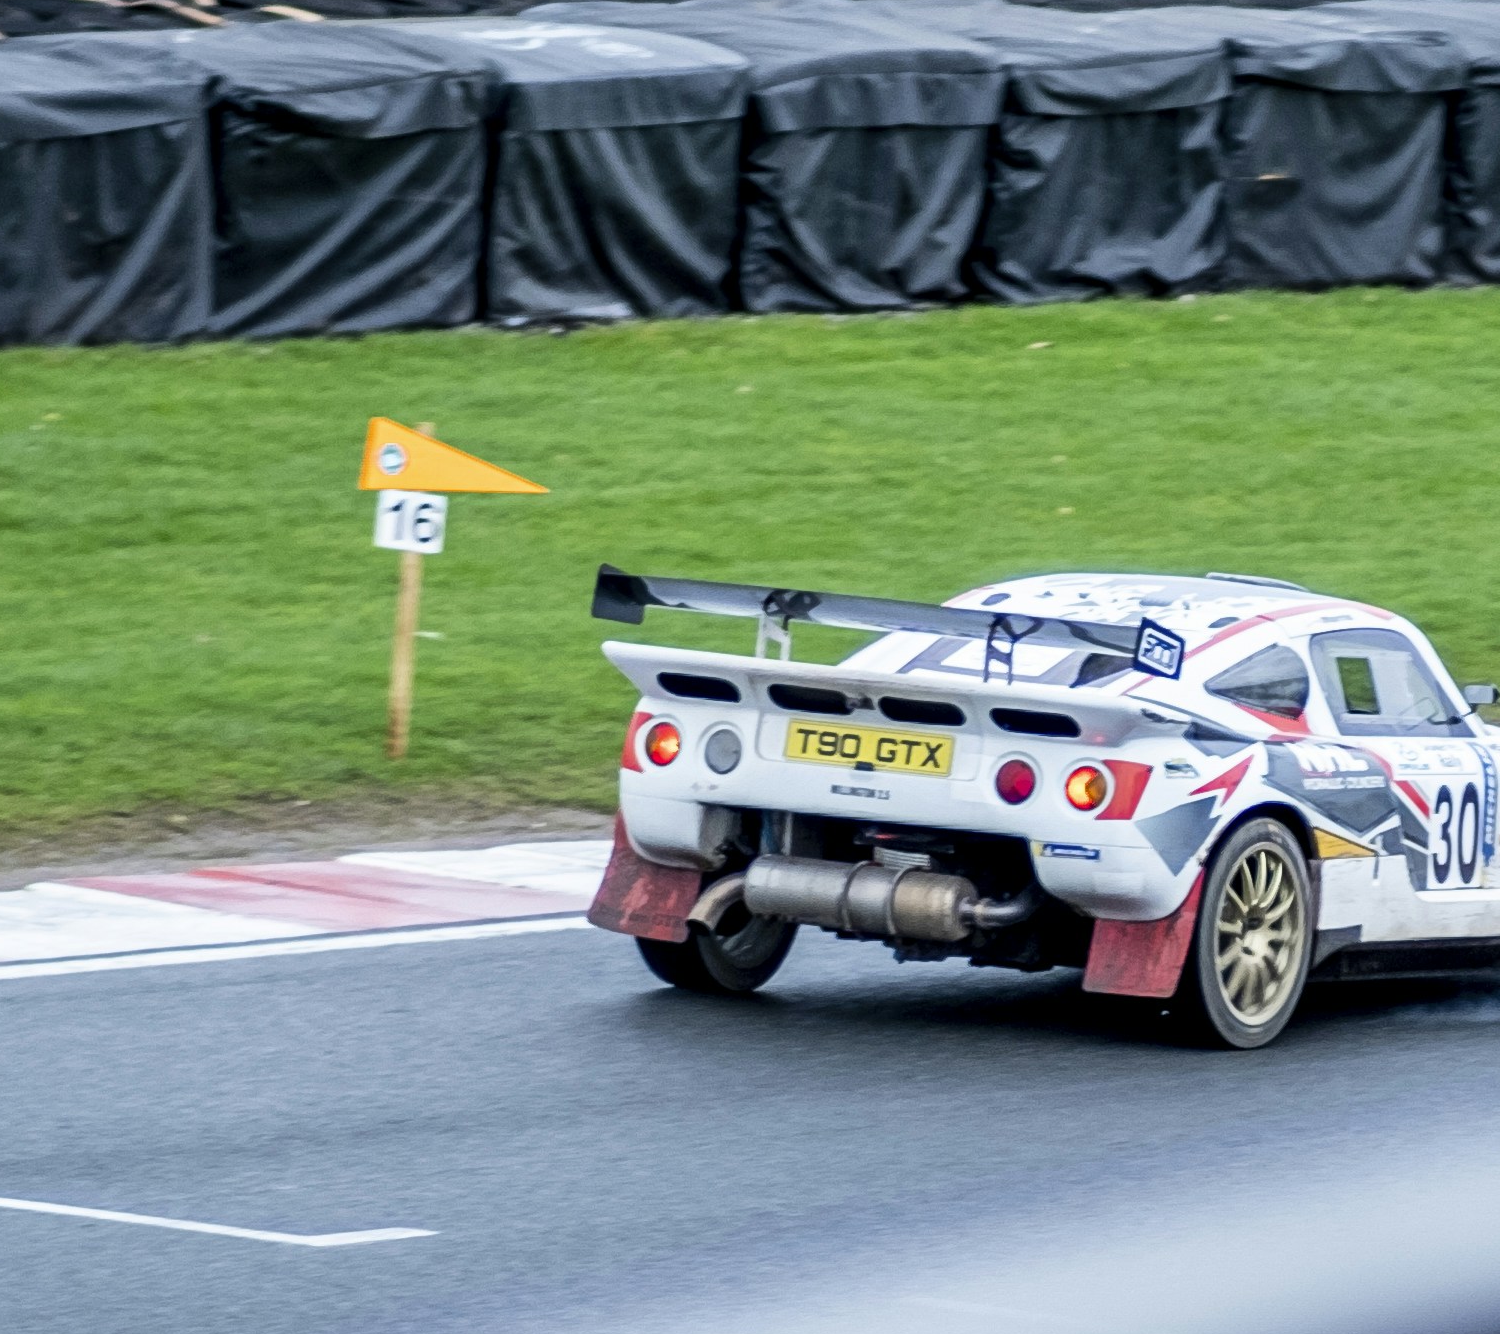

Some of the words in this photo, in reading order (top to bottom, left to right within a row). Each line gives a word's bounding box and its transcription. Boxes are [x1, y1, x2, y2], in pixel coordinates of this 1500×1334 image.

[385, 498, 441, 543] 16
[797, 728, 861, 759] T90
[876, 737, 943, 768] GTX
[1432, 781, 1479, 884] 30
